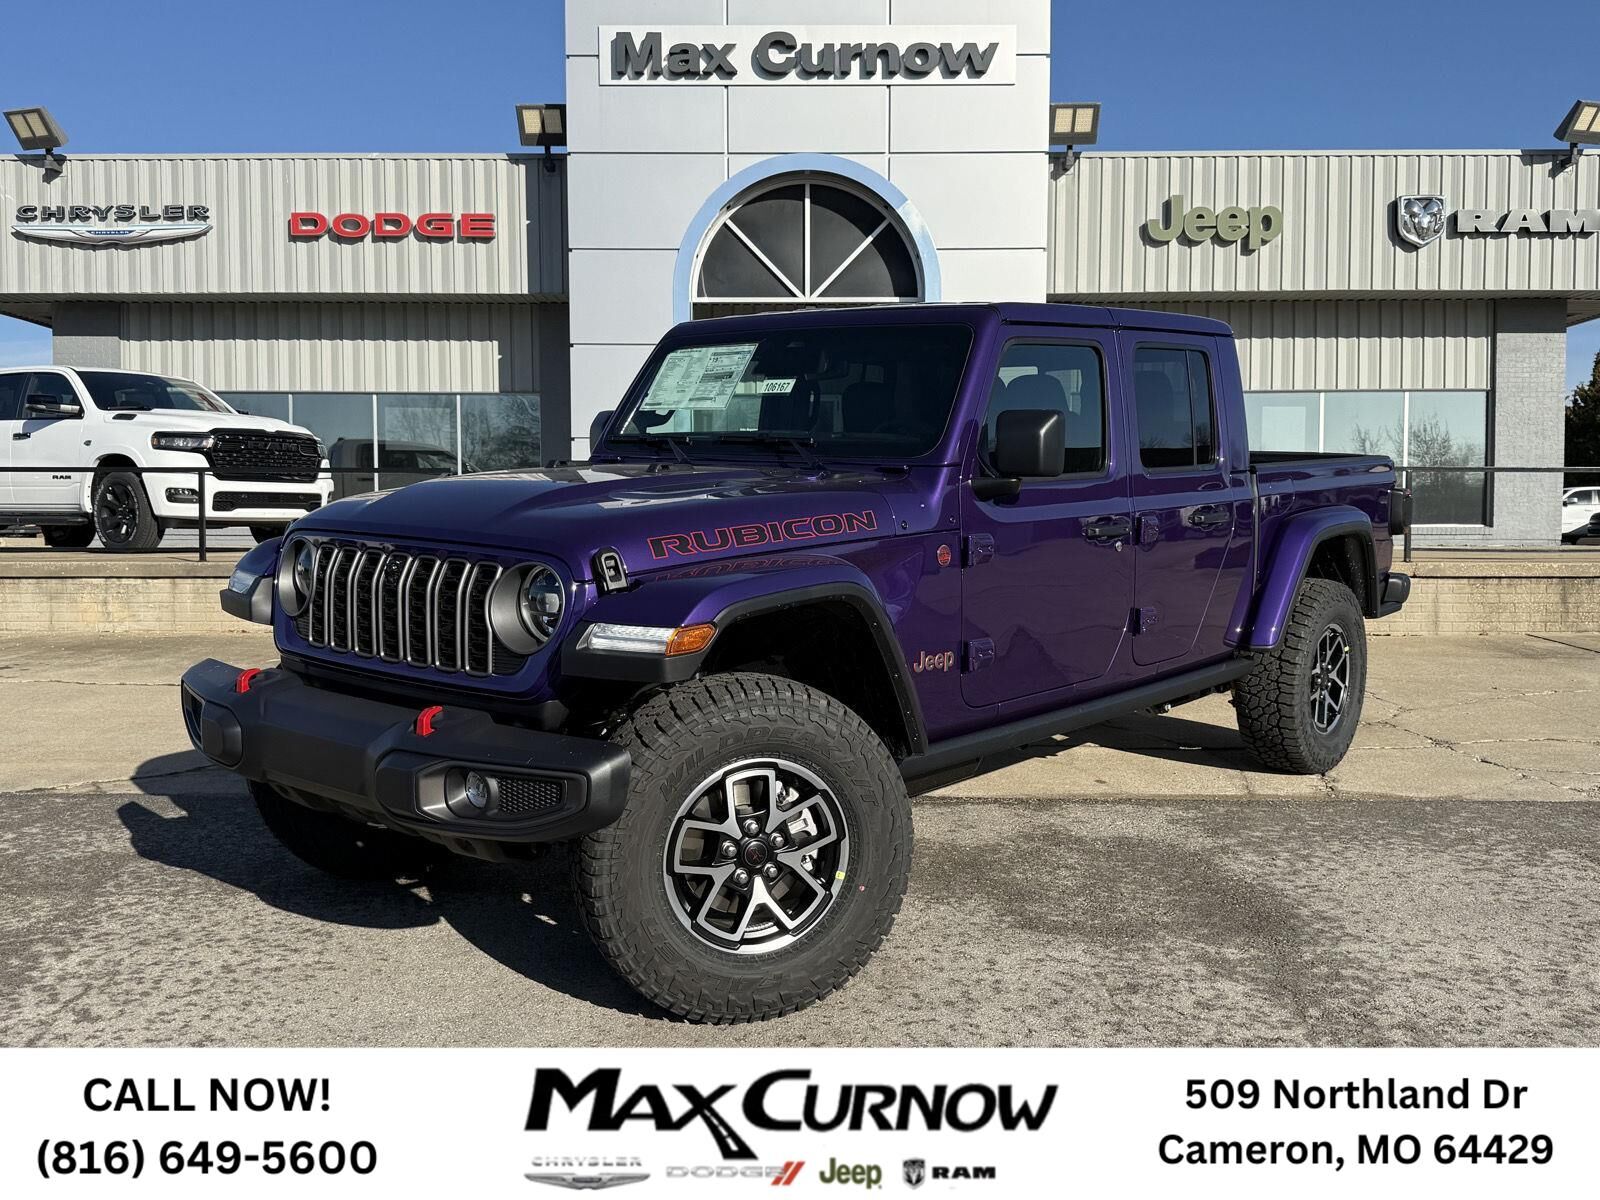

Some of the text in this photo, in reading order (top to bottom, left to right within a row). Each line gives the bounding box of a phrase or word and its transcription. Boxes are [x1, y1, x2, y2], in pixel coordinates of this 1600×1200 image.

[613, 31, 999, 79] Max Curnow
[16, 204, 211, 221] CHRYSLER
[289, 212, 497, 239] DODGE
[1146, 194, 1283, 250] Jeep
[1456, 208, 1600, 233] RAM
[763, 382, 791, 392] 106167
[647, 510, 878, 560] RUBICON
[913, 650, 955, 673] Jeep
